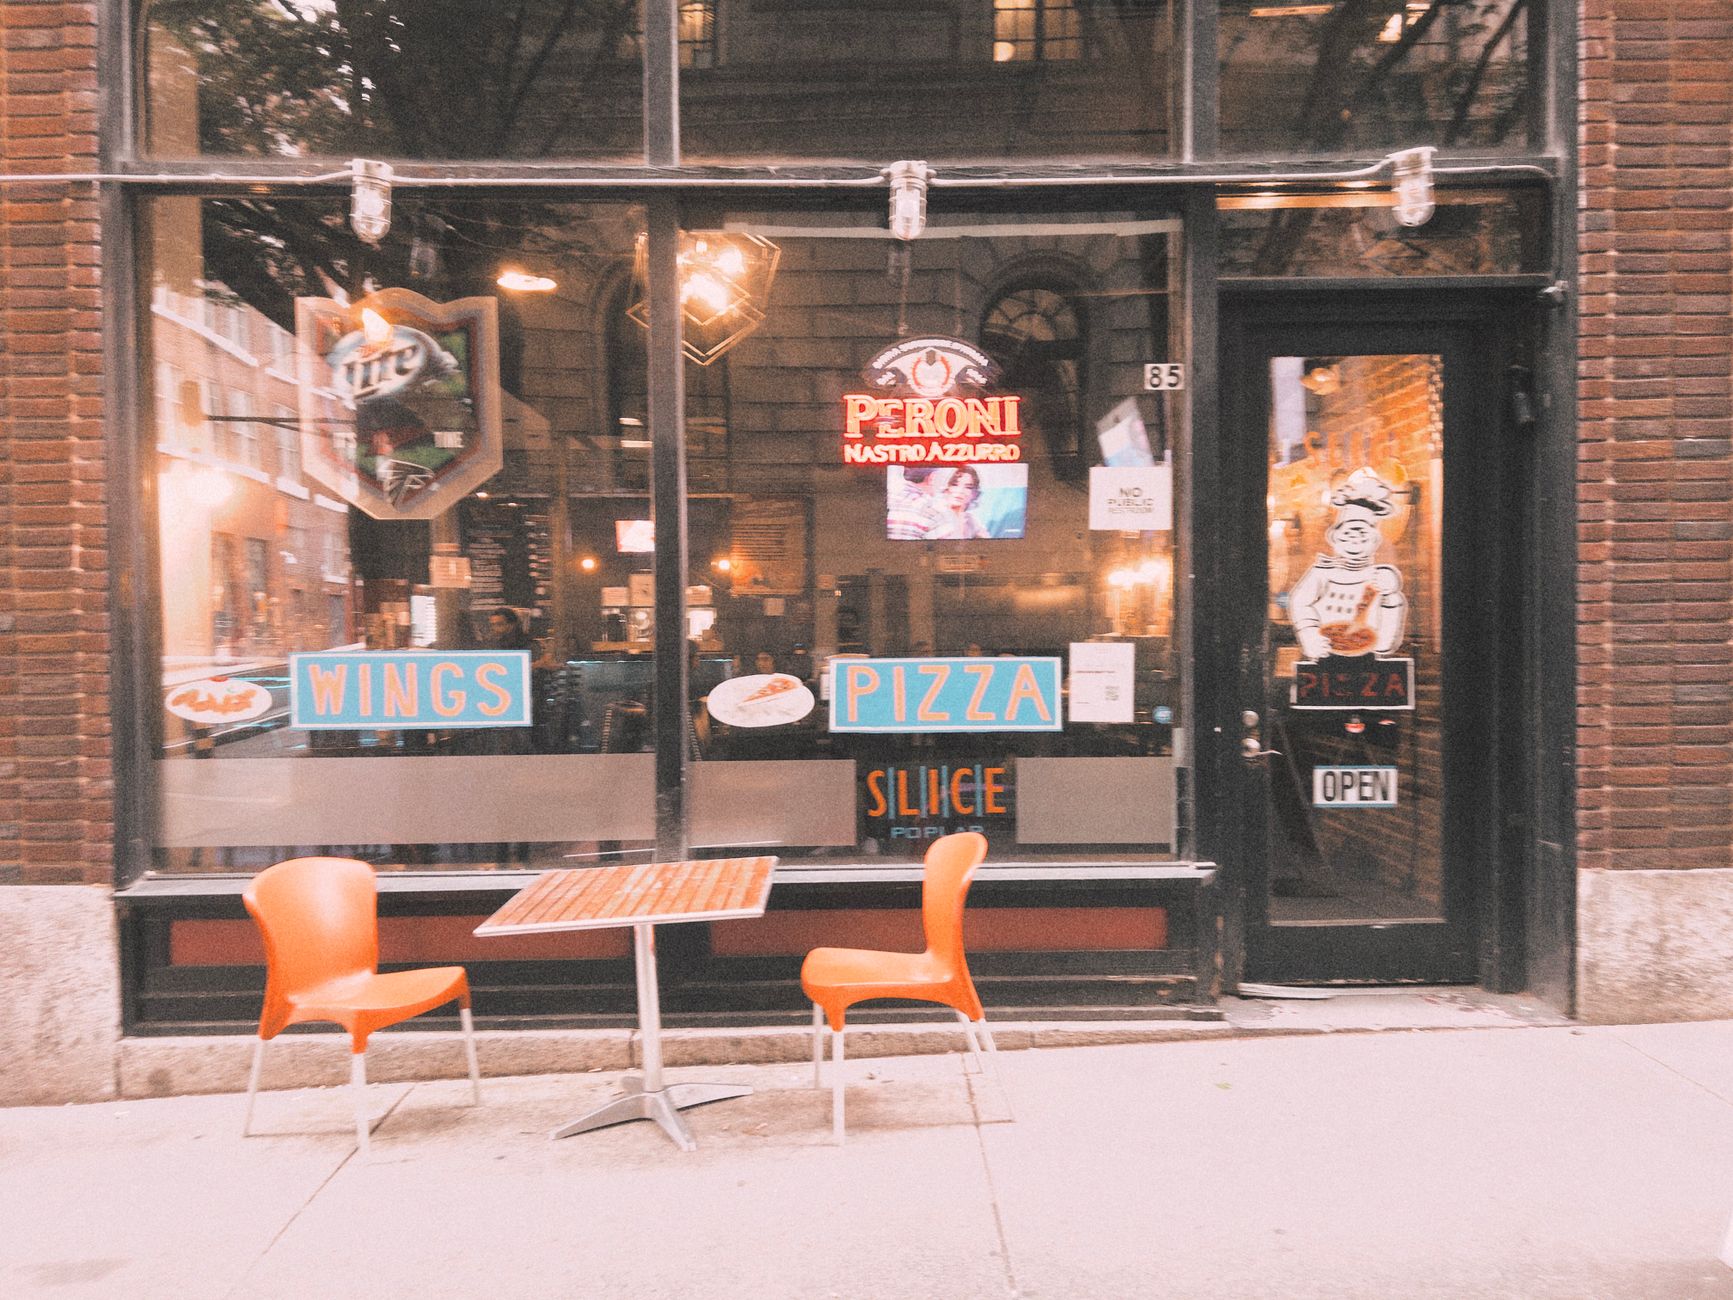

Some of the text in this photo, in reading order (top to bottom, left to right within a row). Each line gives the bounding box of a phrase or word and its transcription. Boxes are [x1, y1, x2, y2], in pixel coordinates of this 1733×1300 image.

[1150, 366, 1180, 388] 85
[843, 394, 1021, 438] PERONI
[844, 441, 1021, 462] NASTRO AZZURRO
[1120, 487, 1142, 498] NO
[308, 662, 511, 717] WINGS
[847, 664, 1051, 722] PIZZA
[866, 767, 1007, 817] SLICE
[1323, 771, 1389, 802] OPEN
